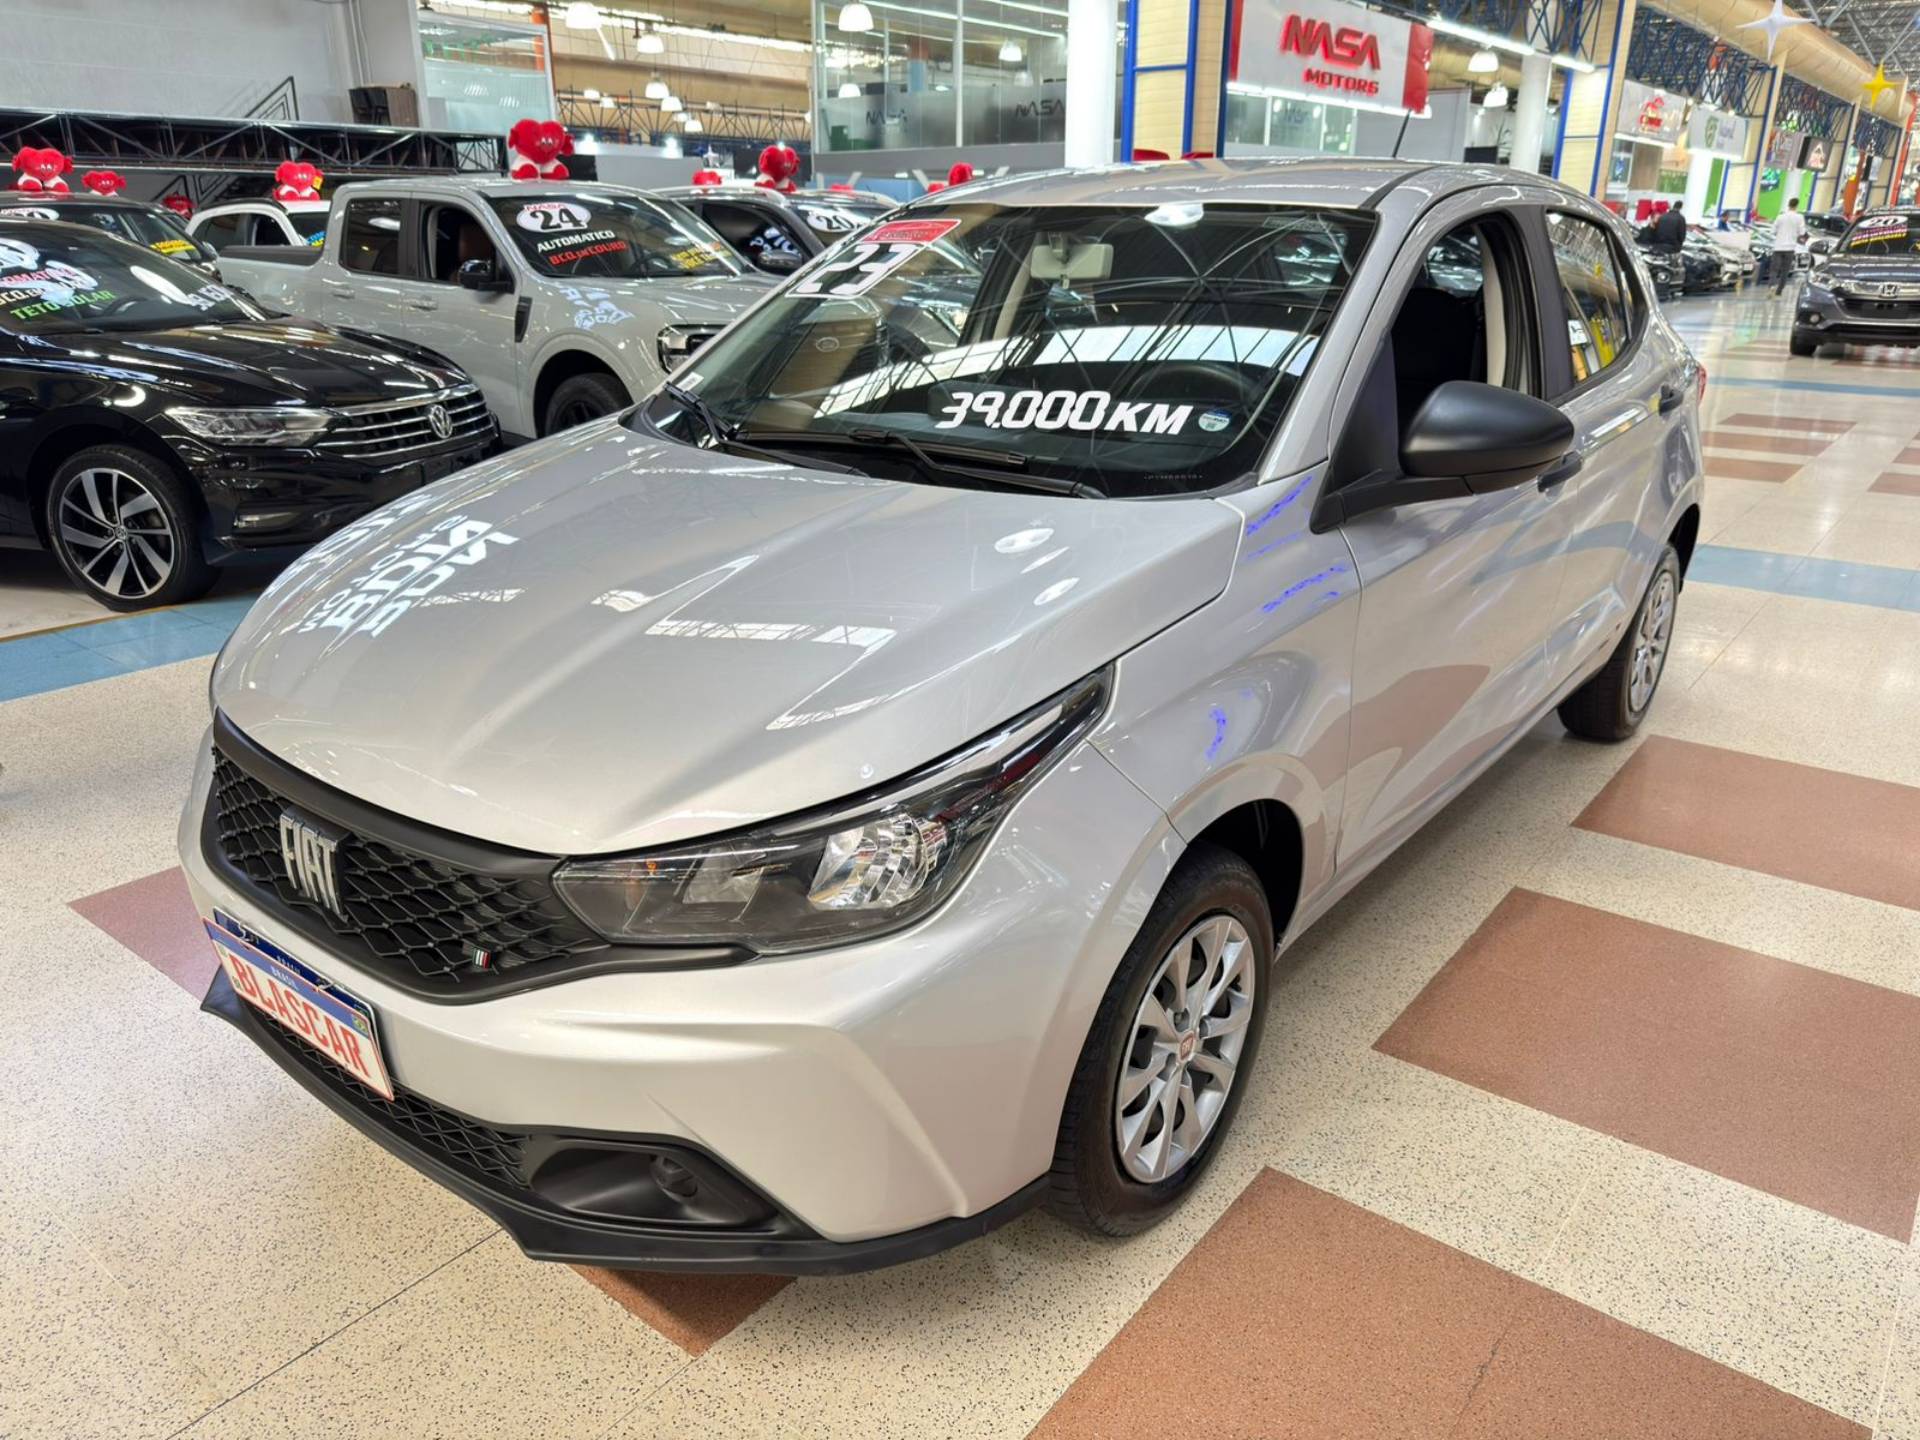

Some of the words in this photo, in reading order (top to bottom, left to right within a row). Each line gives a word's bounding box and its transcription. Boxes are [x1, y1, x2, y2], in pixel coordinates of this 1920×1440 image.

[1281, 14, 1380, 70] NASA
[1305, 68, 1379, 94] MOTORS
[529, 208, 584, 230] 24
[537, 230, 615, 253] AUTOMATICO
[795, 242, 921, 295] 23
[10, 300, 61, 319] TETO
[279, 812, 347, 923] FIAT
[228, 952, 372, 1079] BLASCAR
